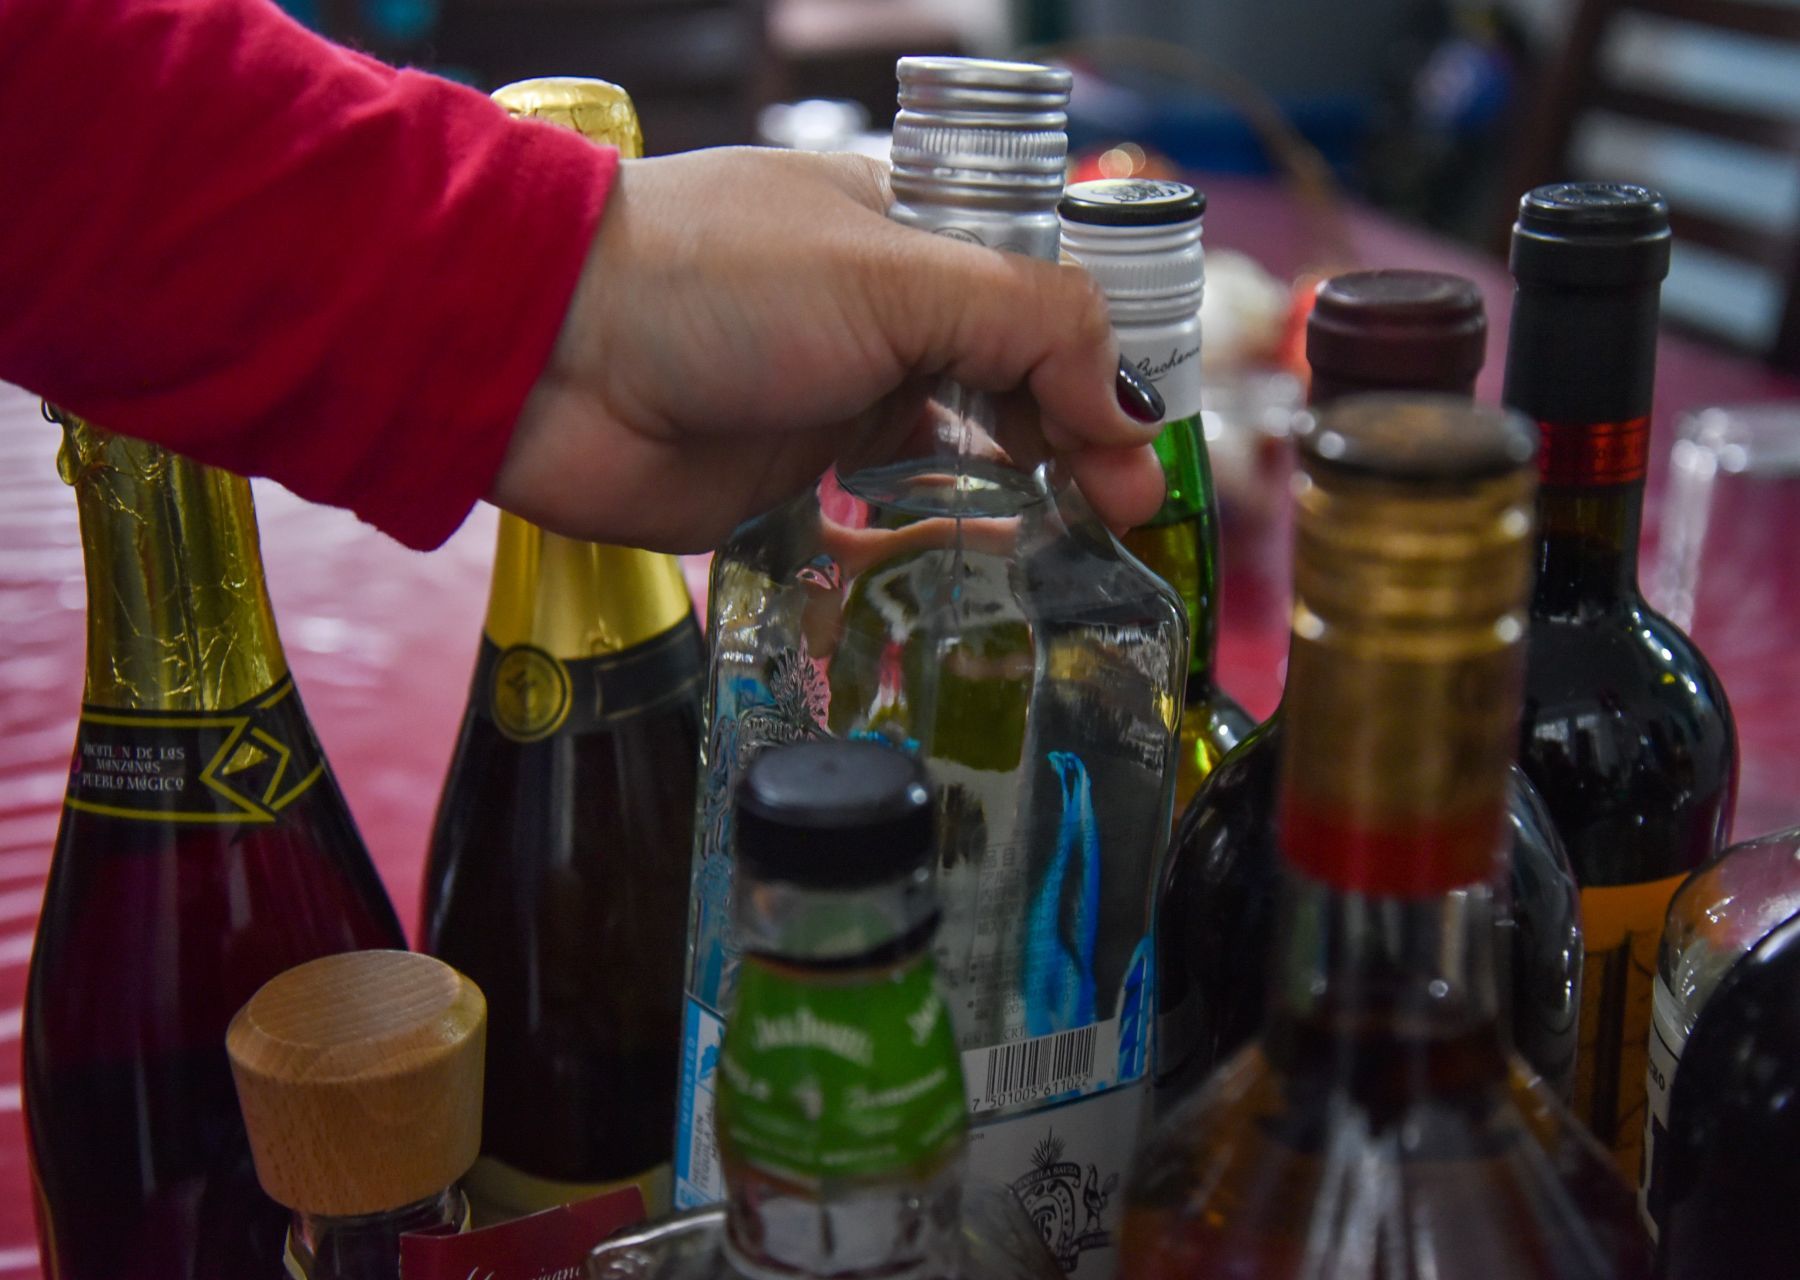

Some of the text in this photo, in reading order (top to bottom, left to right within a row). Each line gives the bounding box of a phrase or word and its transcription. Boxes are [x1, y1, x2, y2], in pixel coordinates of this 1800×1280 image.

[136, 746, 153, 758] DE
[160, 746, 185, 760] LAS
[82, 772, 124, 789] PUEBLO
[972, 1098, 980, 1113] 7
[990, 1087, 1038, 1108] 501005
